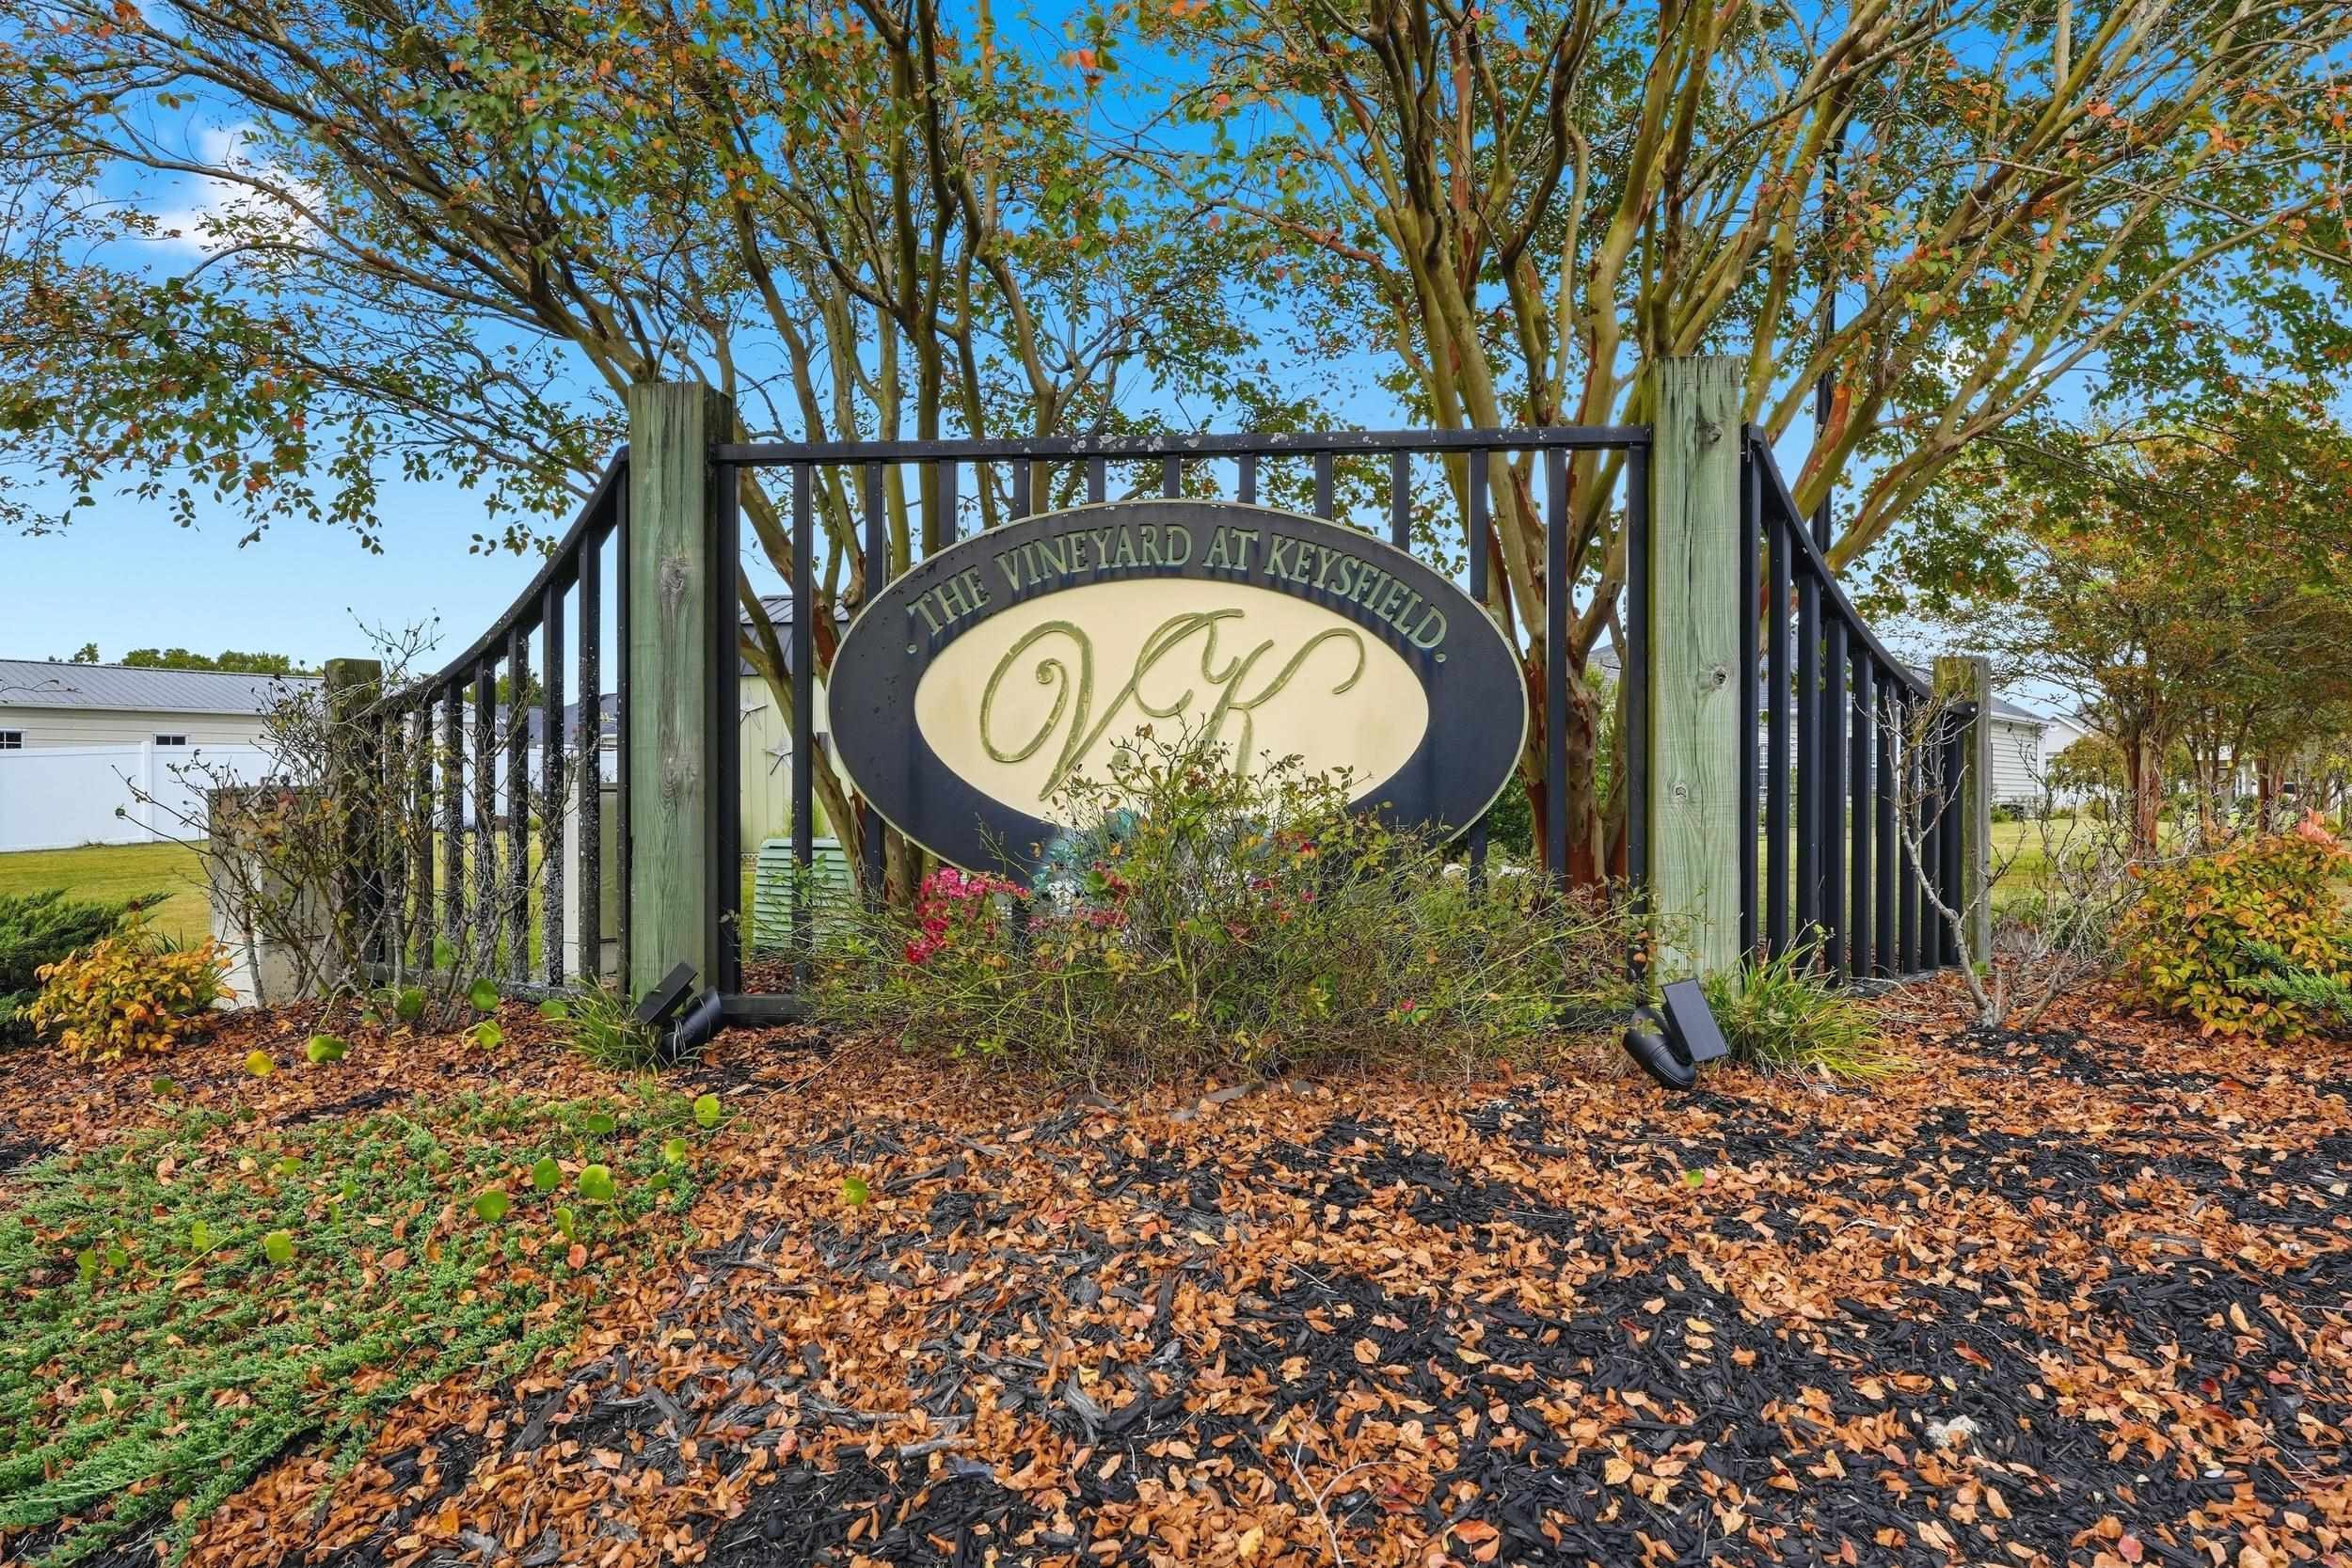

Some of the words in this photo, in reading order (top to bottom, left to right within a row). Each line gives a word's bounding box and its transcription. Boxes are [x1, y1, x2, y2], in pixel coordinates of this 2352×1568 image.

[905, 564, 992, 637] THE
[993, 523, 1193, 592] VINEYARD
[1201, 525, 1260, 571] AT
[1263, 532, 1448, 649] KEYSFIELD
